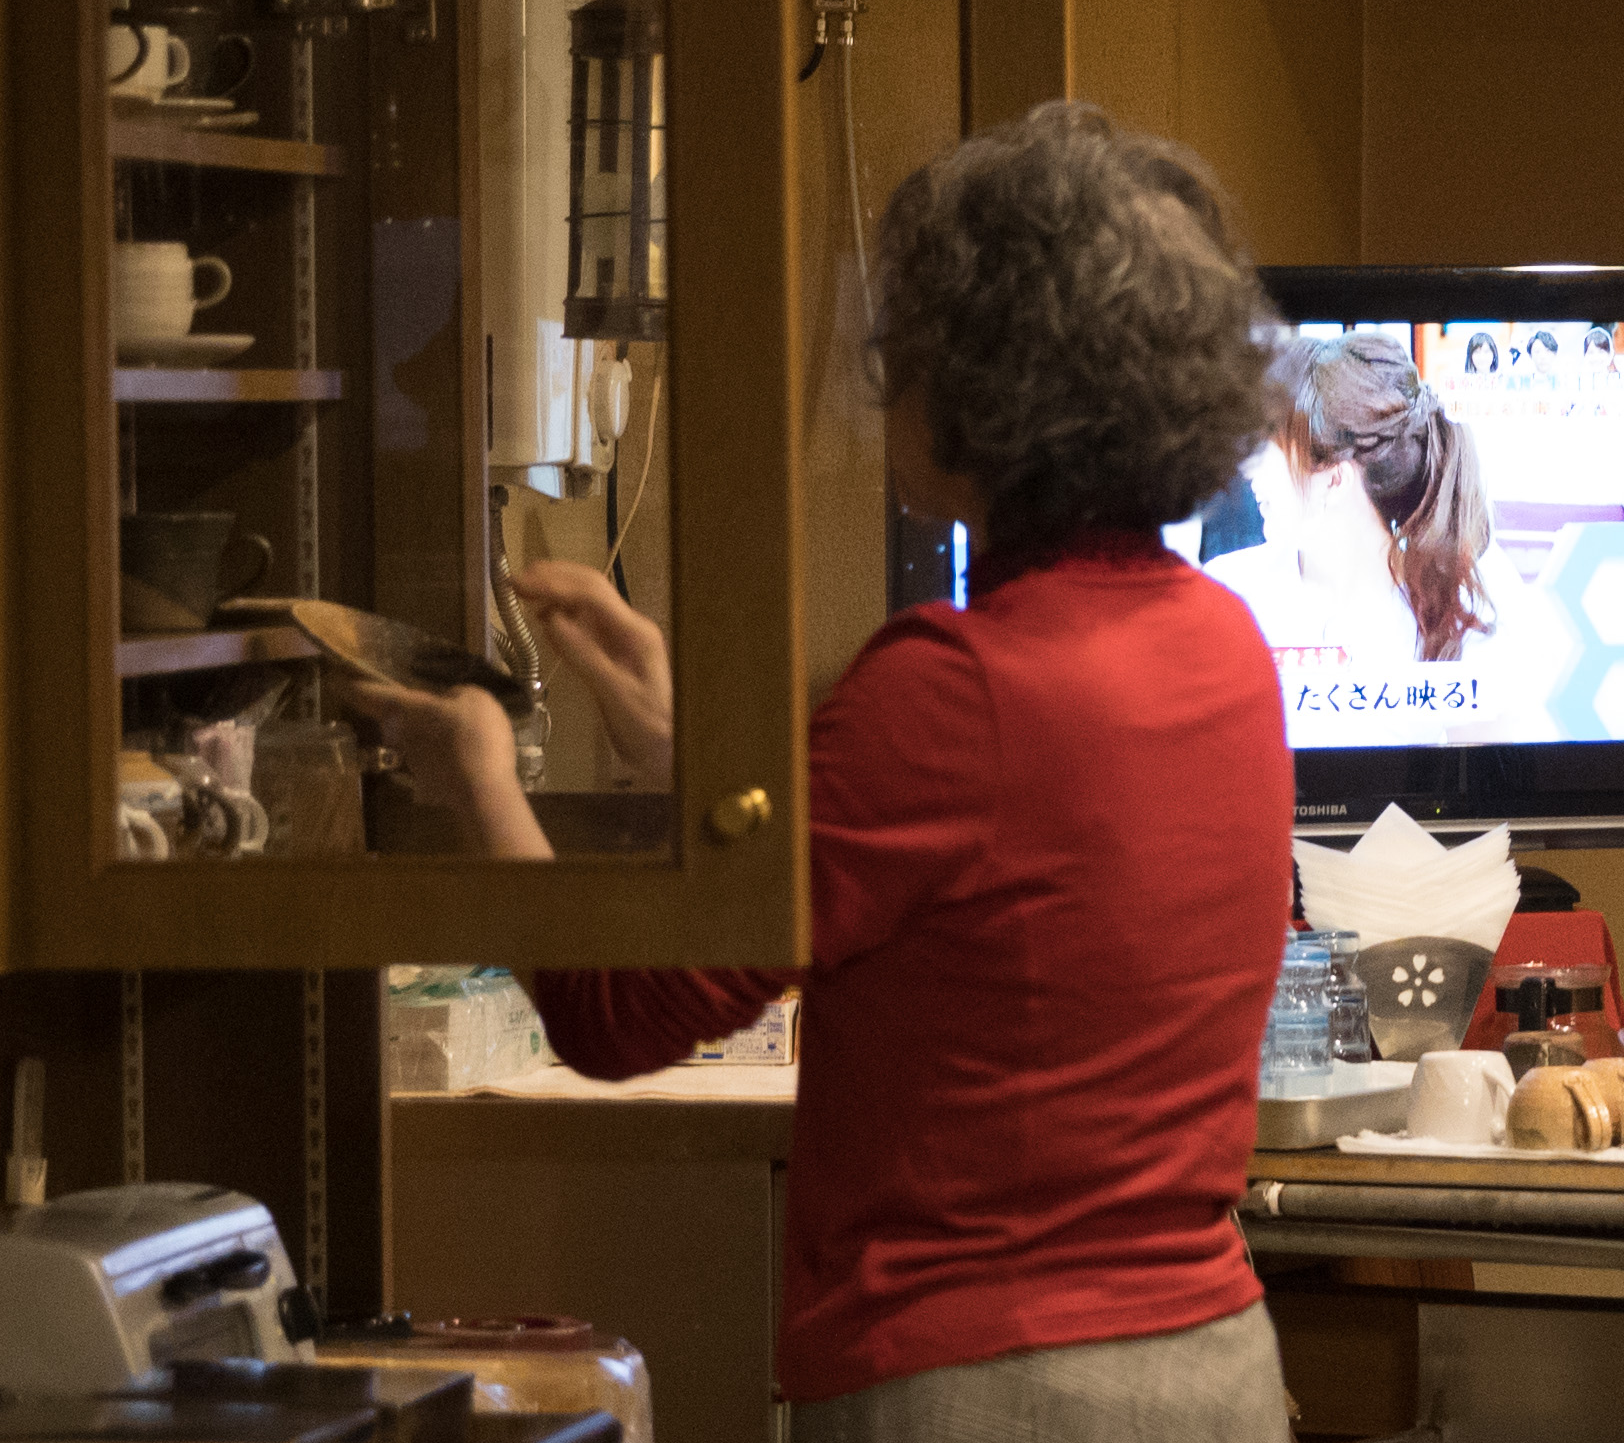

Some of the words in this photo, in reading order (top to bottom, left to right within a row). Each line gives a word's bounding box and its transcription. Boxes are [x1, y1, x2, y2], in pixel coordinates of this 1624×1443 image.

[1296, 678, 1478, 712] たくさん映る!
[1293, 804, 1348, 816] TOSHIBA
